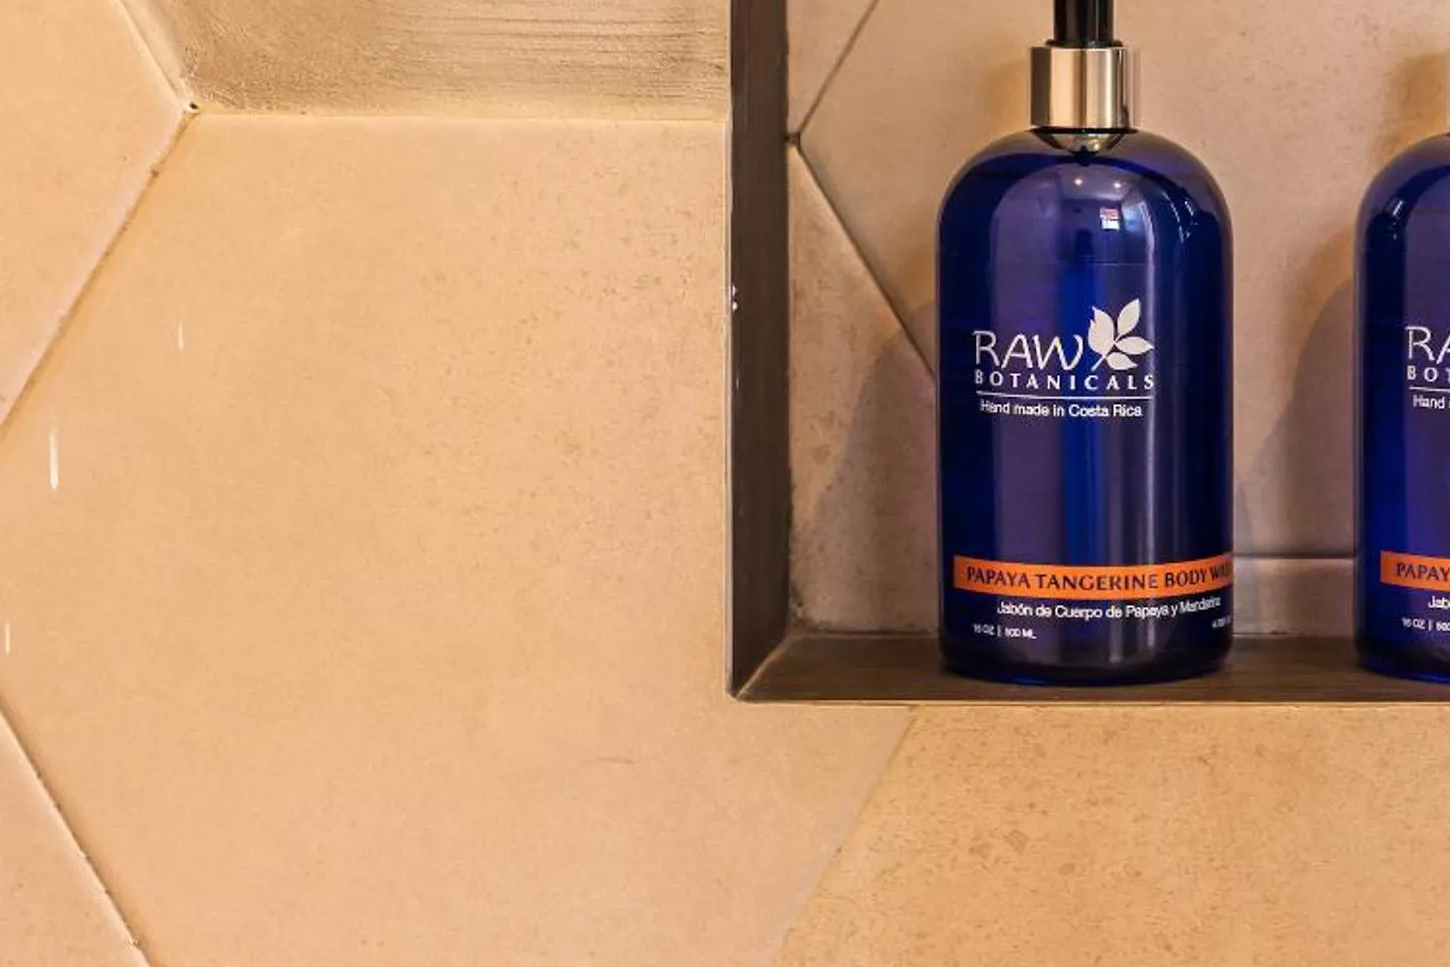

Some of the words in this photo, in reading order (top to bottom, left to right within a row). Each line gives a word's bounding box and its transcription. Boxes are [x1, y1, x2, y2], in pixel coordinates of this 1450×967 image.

[972, 330, 1084, 370] RAW
[974, 369, 1155, 390] BOTANICALS
[980, 398, 1010, 415] Hand
[1014, 401, 1049, 416] made
[1053, 404, 1065, 416] in
[1068, 404, 1109, 417] Costa
[1113, 404, 1143, 417] Rica
[1413, 394, 1445, 410] Hand
[966, 565, 1031, 589] PAPAYA
[1035, 573, 1159, 591] TANGERINE
[1165, 568, 1207, 587] BODY
[997, 601, 1033, 616] Jabón
[1035, 605, 1052, 618] de
[1055, 605, 1103, 621] Cuerpo
[1105, 605, 1122, 618] de
[1125, 605, 1169, 619] Papaya
[1171, 605, 1178, 617] y
